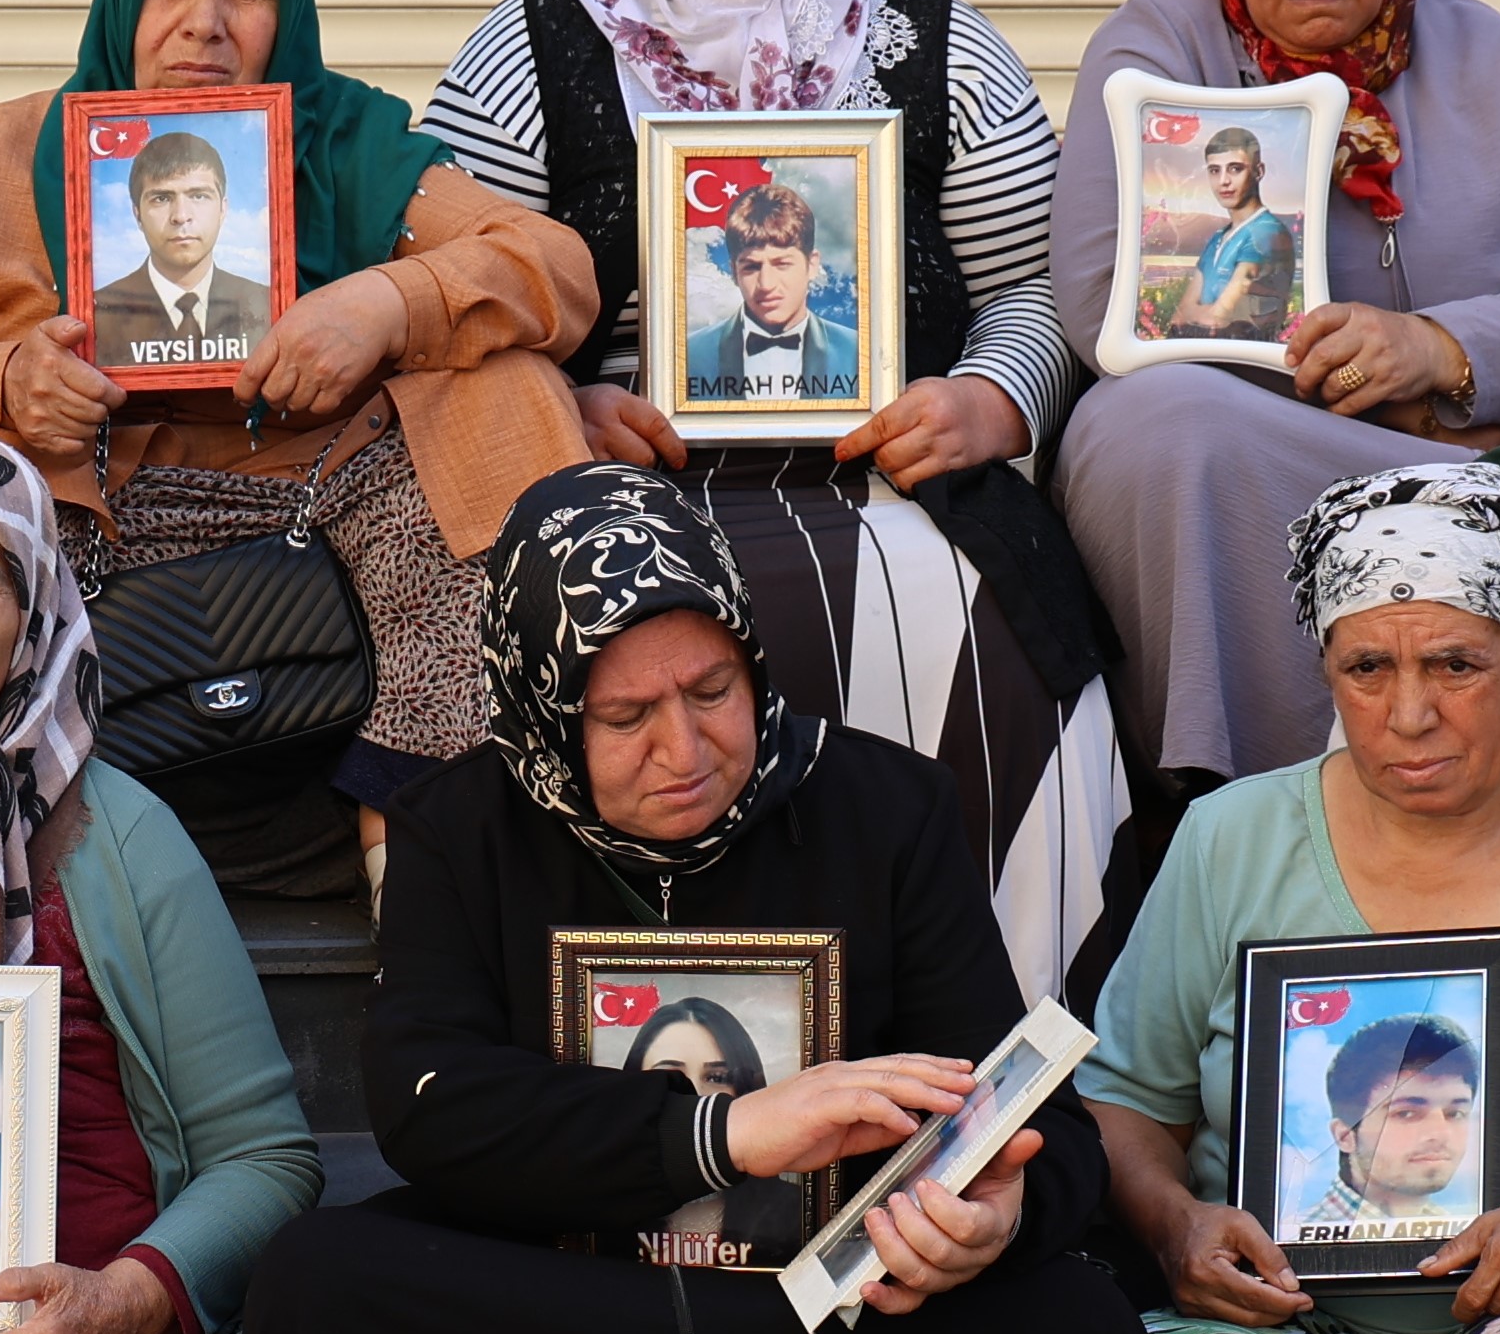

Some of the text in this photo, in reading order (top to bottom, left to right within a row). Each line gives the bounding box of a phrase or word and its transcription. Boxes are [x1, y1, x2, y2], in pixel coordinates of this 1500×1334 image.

[130, 333, 249, 363] VEYSİ DİRİ
[688, 373, 858, 397] EMRAH PANAY
[637, 1231, 753, 1266] Nilüfer
